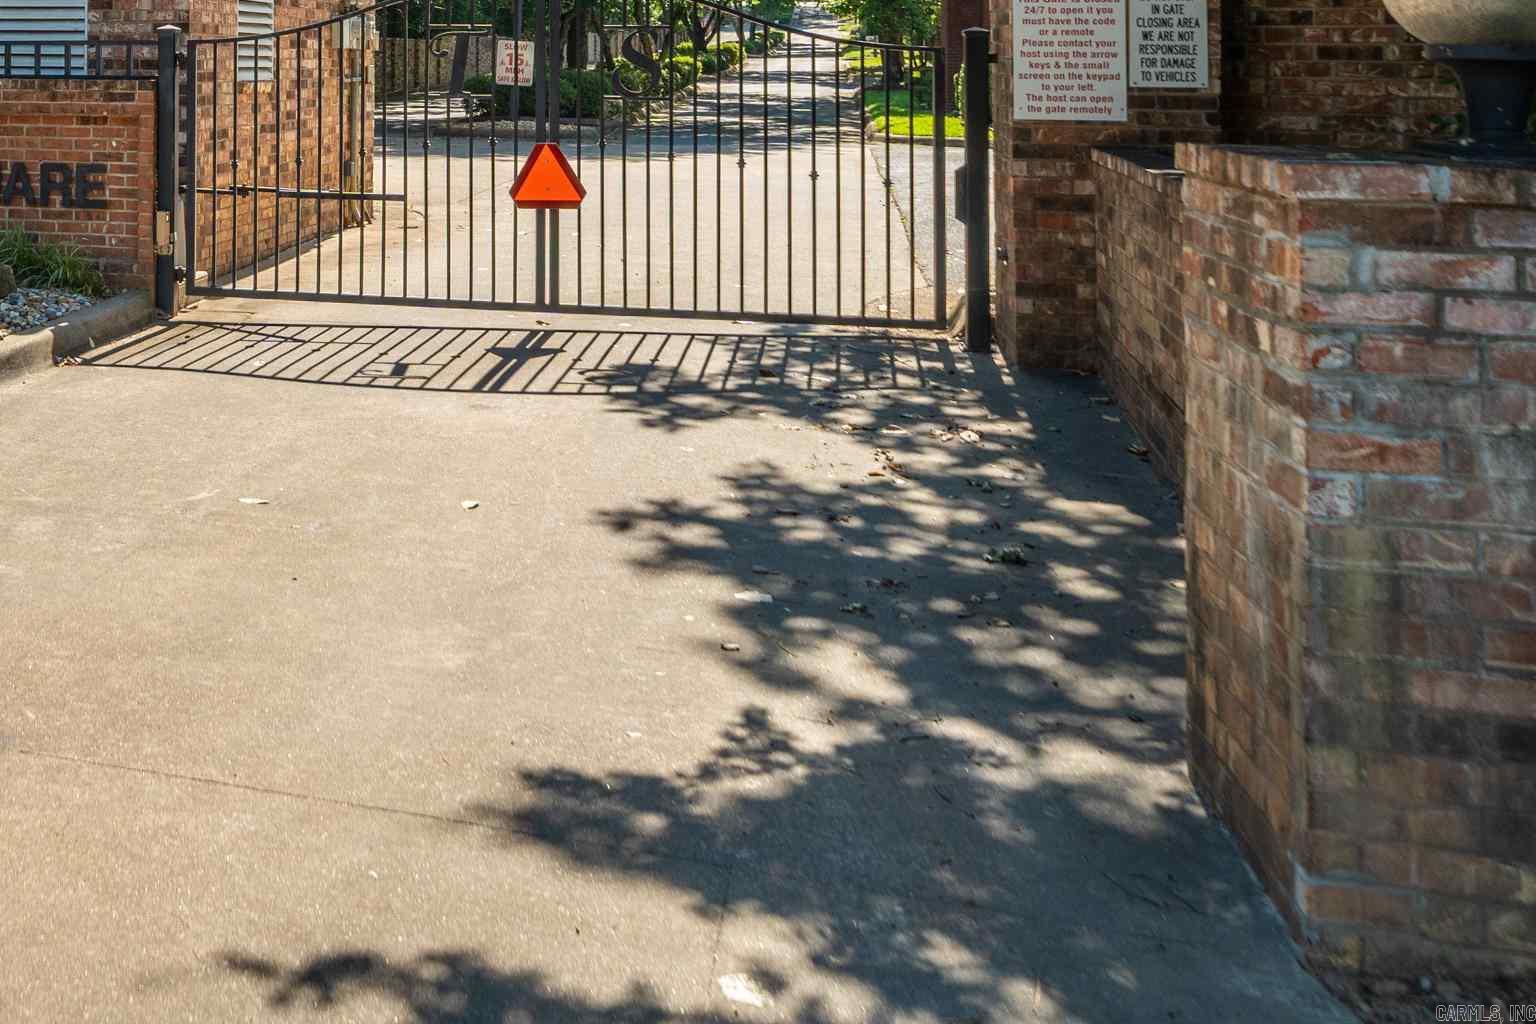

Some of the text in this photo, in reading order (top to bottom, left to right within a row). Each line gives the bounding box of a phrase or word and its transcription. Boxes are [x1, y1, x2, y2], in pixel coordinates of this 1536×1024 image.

[1024, 6, 1045, 14] 24/7
[1060, 8, 1084, 16] open
[1096, 8, 1113, 16] you
[1151, 4, 1184, 15] IN GATE
[1022, 17, 1116, 25] must have the code
[1136, 17, 1200, 28] CLOSING AREA
[1061, 28, 1095, 36] remote
[1141, 30, 1194, 41] WE ARE NOT
[505, 43, 528, 51] SLW
[1022, 38, 1117, 48] Please contact your
[1043, 50, 1069, 59] using
[1138, 44, 1198, 56] RESPONSIBLE
[506, 52, 524, 66] 15
[1140, 57, 1196, 69] FOR DAMAGE
[1028, 61, 1050, 70] keys
[1064, 61, 1080, 69] the
[1083, 61, 1110, 69] small
[1068, 72, 1083, 80] the
[1086, 72, 1121, 81] keypad
[1141, 70, 1197, 82] TO VEHICLES
[1041, 83, 1051, 91] to
[1025, 94, 1043, 102] The
[1046, 94, 1067, 102] host
[1090, 96, 1114, 104] open
[1027, 105, 1112, 115] the gate remotely
